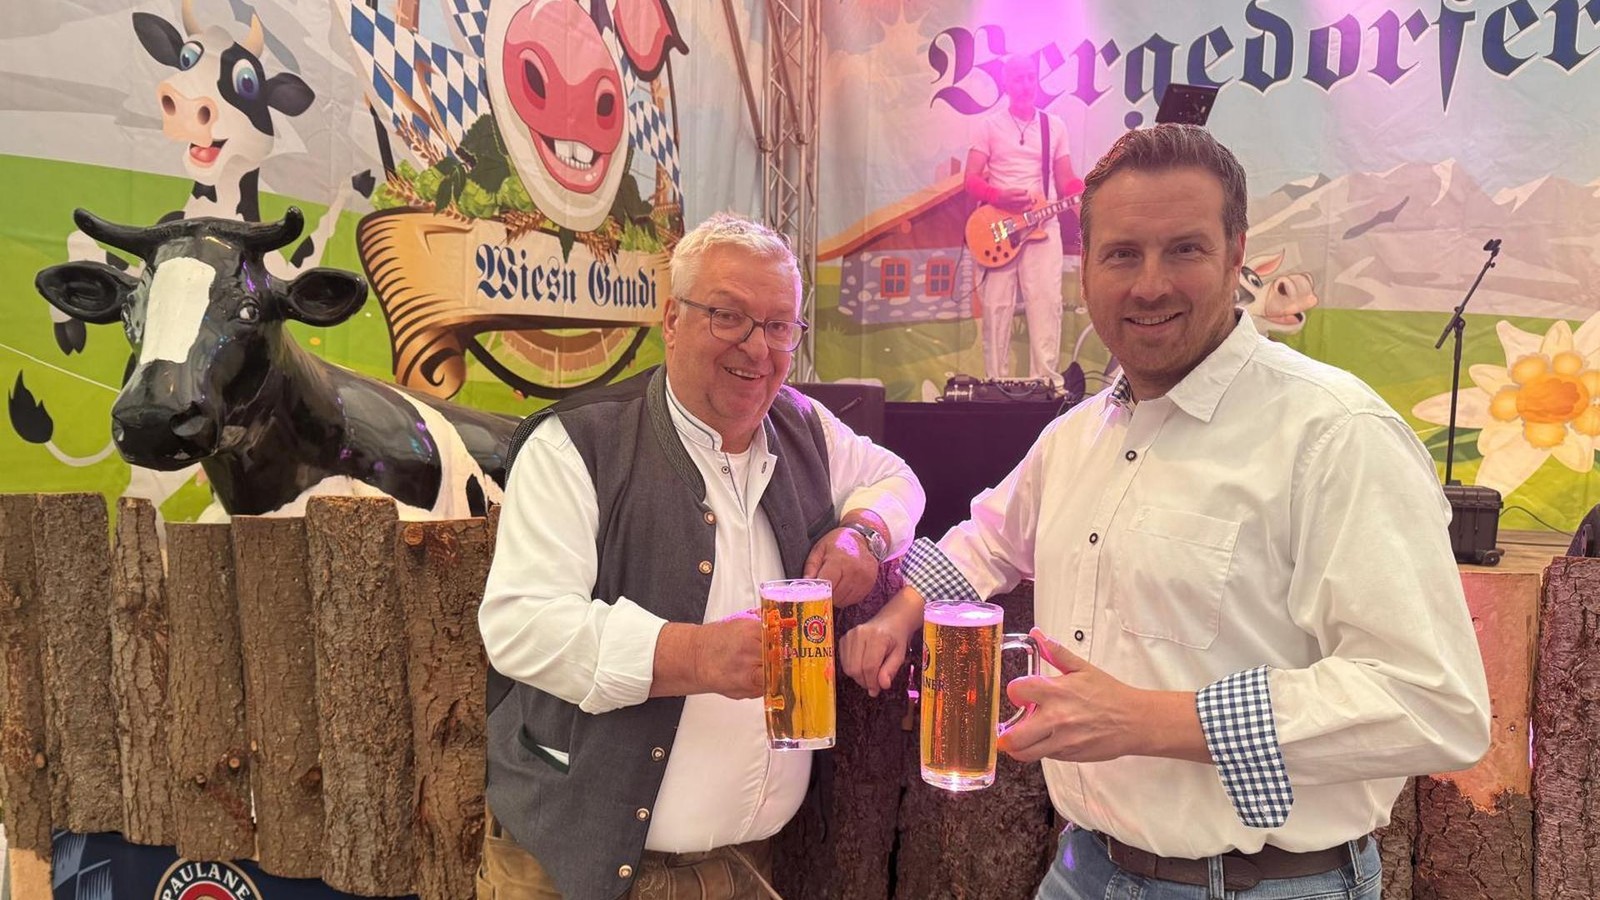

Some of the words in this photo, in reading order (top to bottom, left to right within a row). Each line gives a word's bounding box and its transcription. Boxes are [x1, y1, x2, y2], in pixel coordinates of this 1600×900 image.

[928, 0, 1600, 130] Bergedorfer
[475, 243, 577, 304] Wiesn
[587, 259, 657, 308] Gaudi
